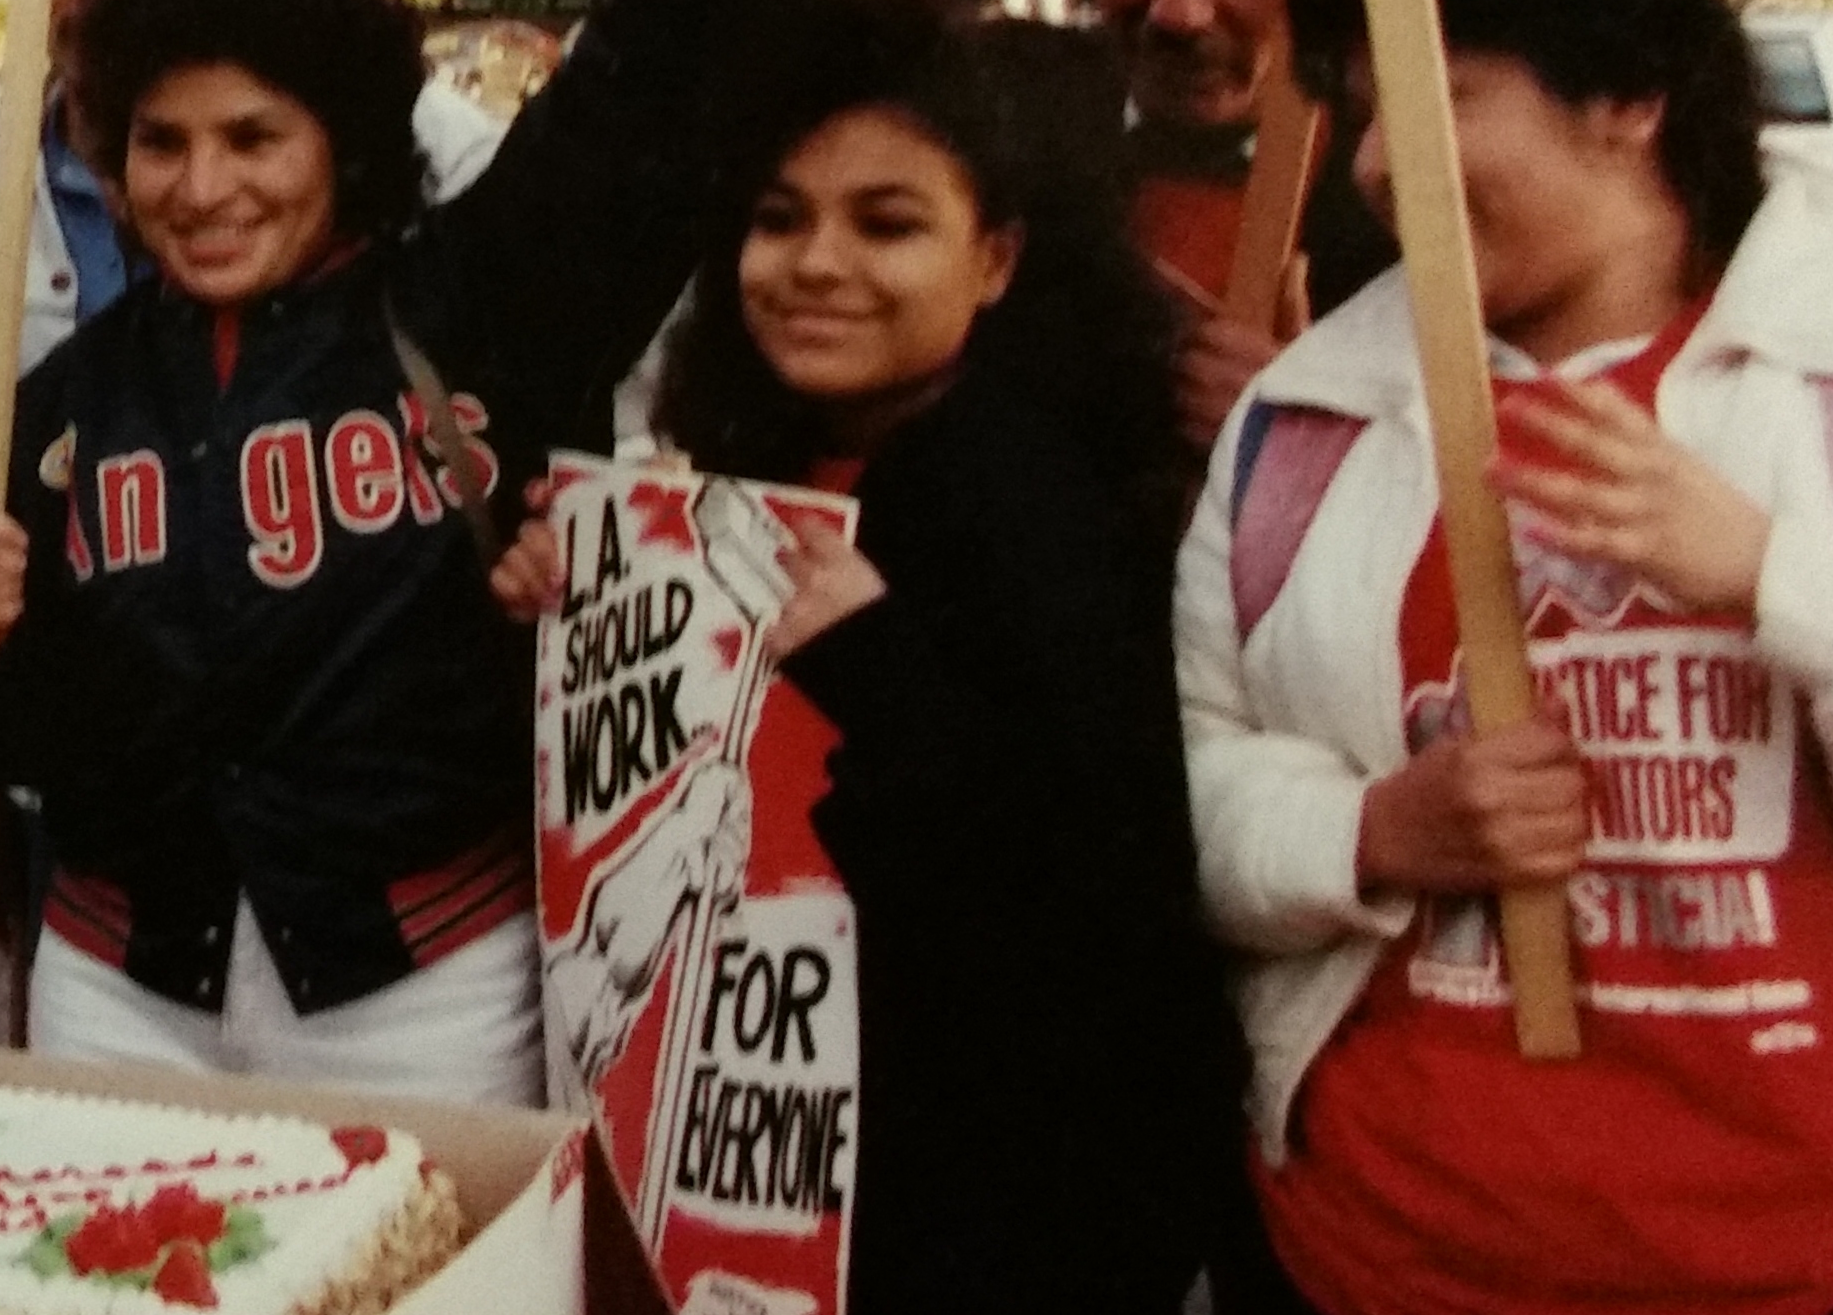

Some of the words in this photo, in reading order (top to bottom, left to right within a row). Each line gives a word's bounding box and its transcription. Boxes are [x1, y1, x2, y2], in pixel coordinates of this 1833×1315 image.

[561, 495, 630, 623] L.A.
[562, 576, 693, 695] SHOULD
[700, 941, 830, 1065] FOR
[676, 1065, 852, 1214] EVERYONE
